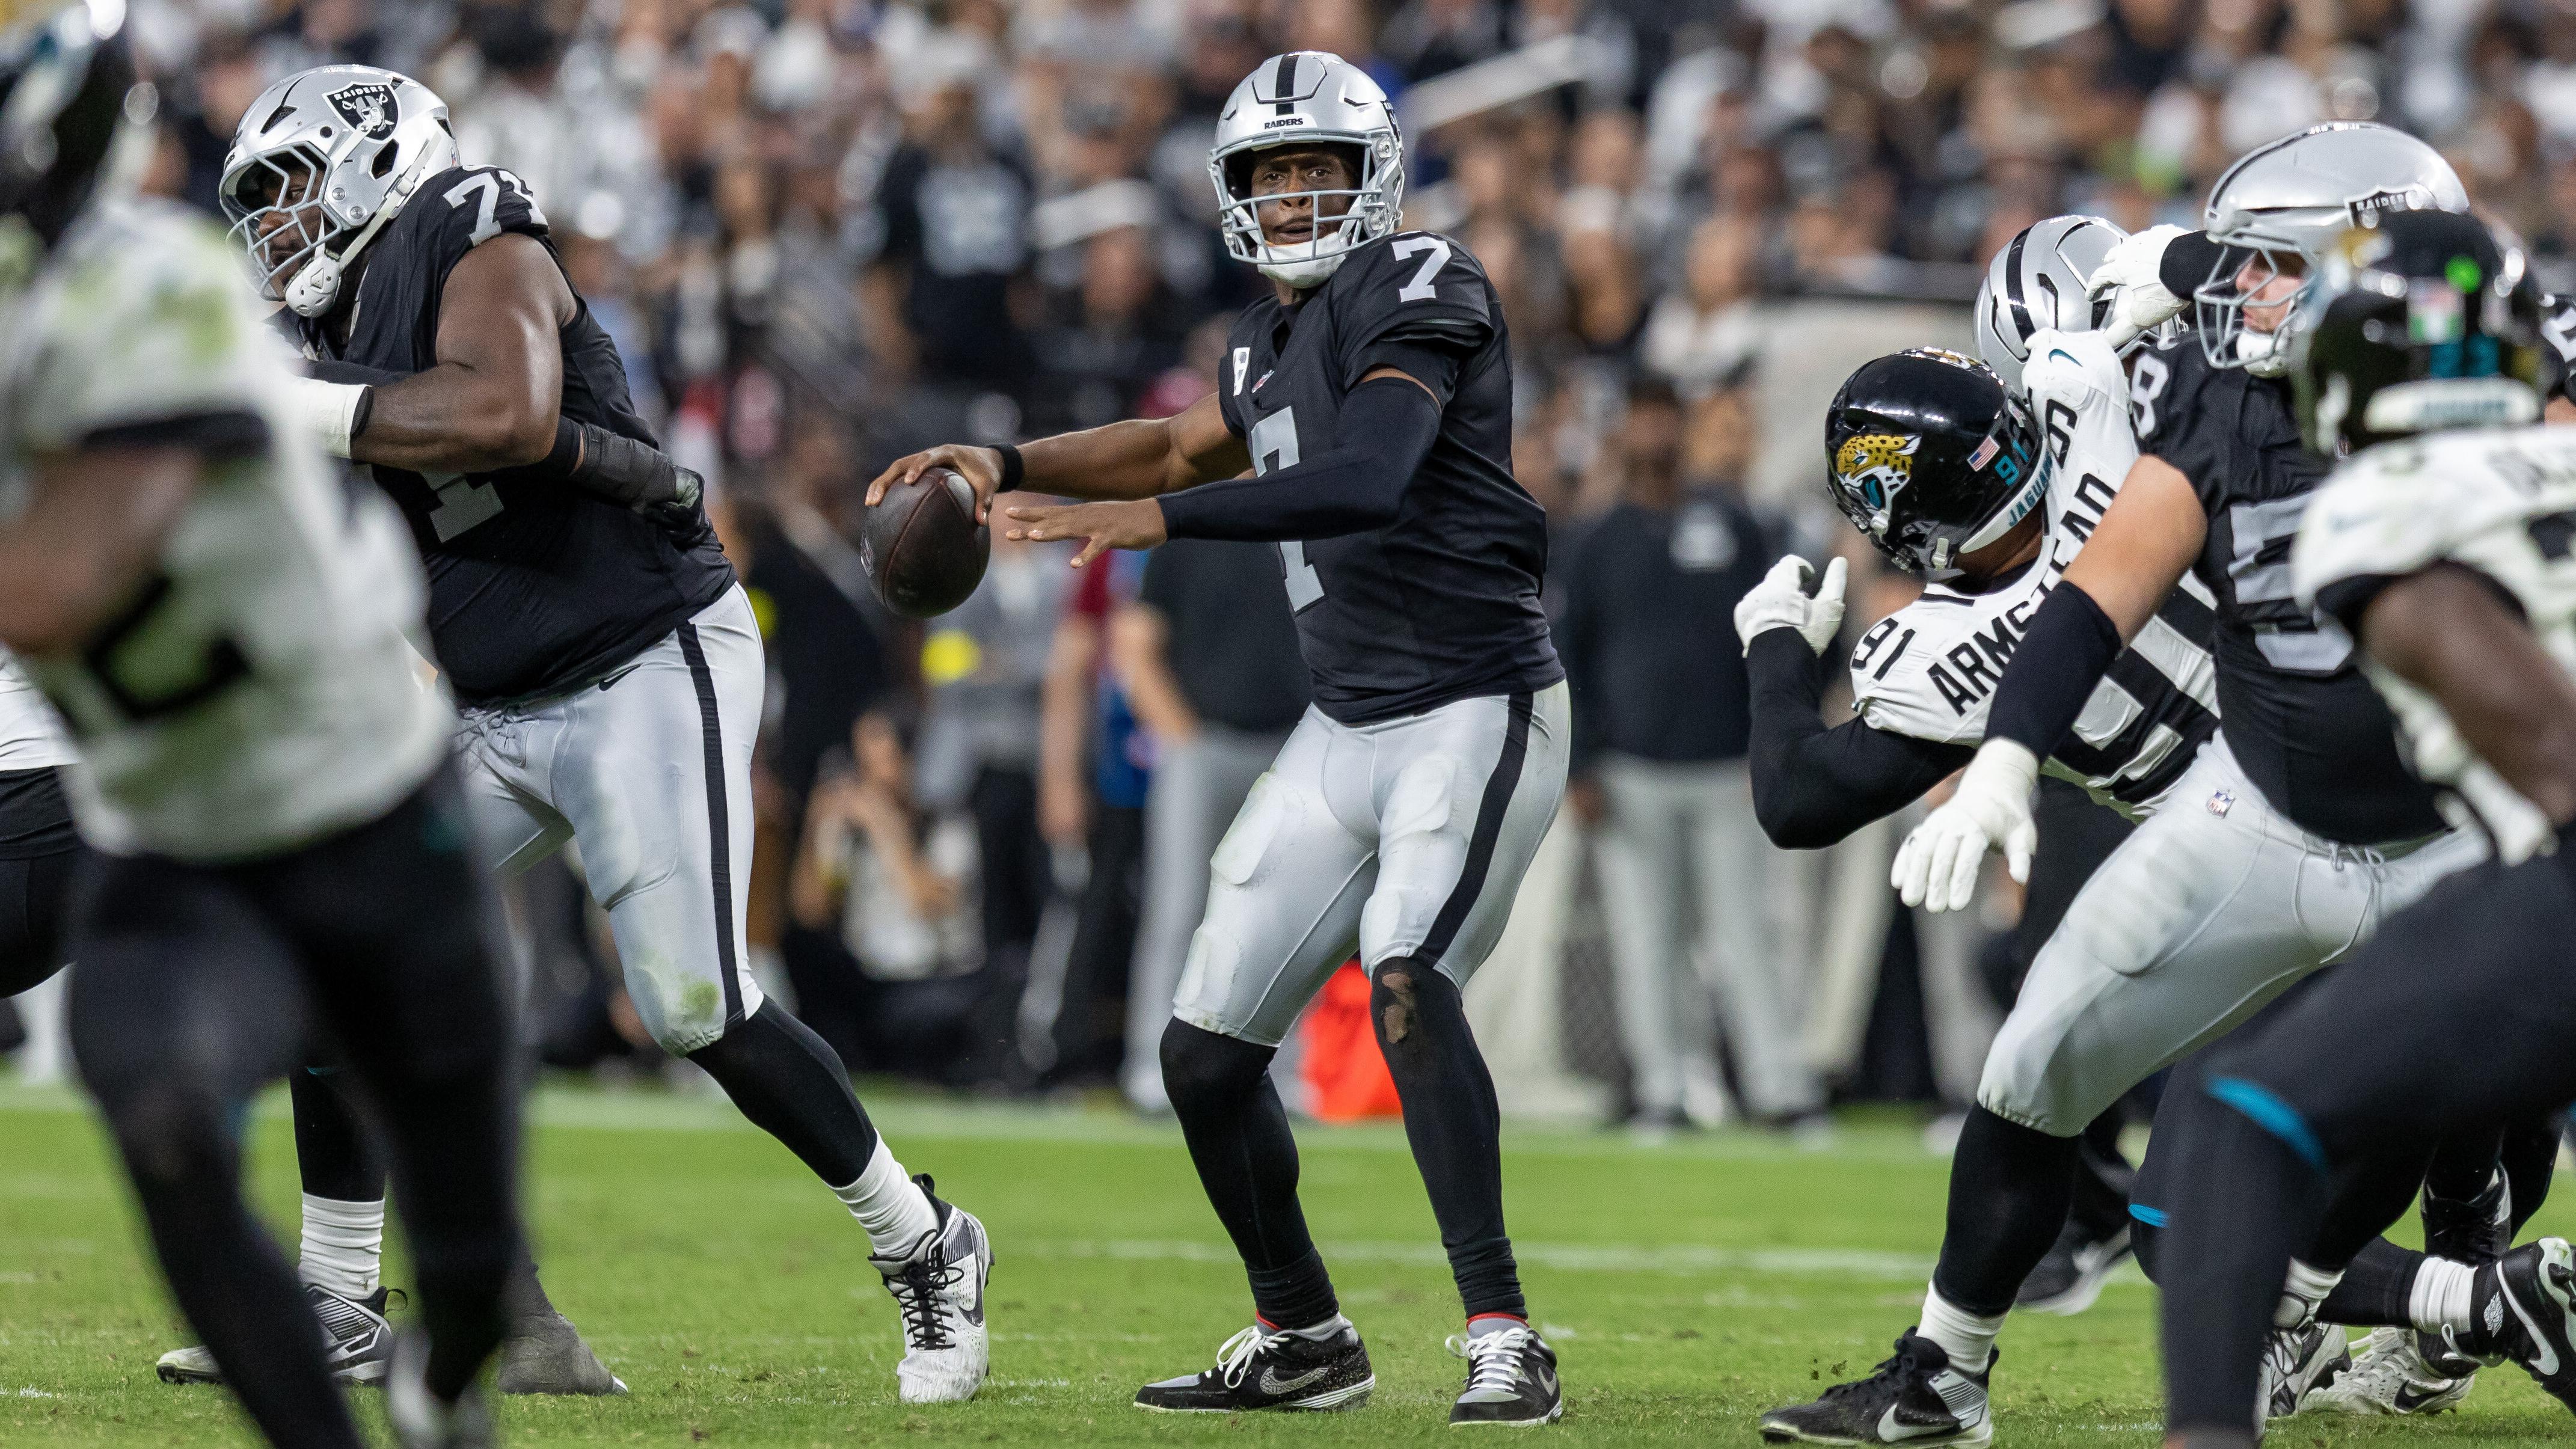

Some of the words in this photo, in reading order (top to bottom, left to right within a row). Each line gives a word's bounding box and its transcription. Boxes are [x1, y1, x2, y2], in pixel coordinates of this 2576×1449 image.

[333, 85, 385, 101] RAIDERS
[1265, 118, 1304, 130] RAIDERS
[2356, 193, 2406, 212] RAIDER
[1391, 236, 1452, 303] 7
[1994, 439, 2029, 486] 91
[1851, 617, 1917, 682] 91
